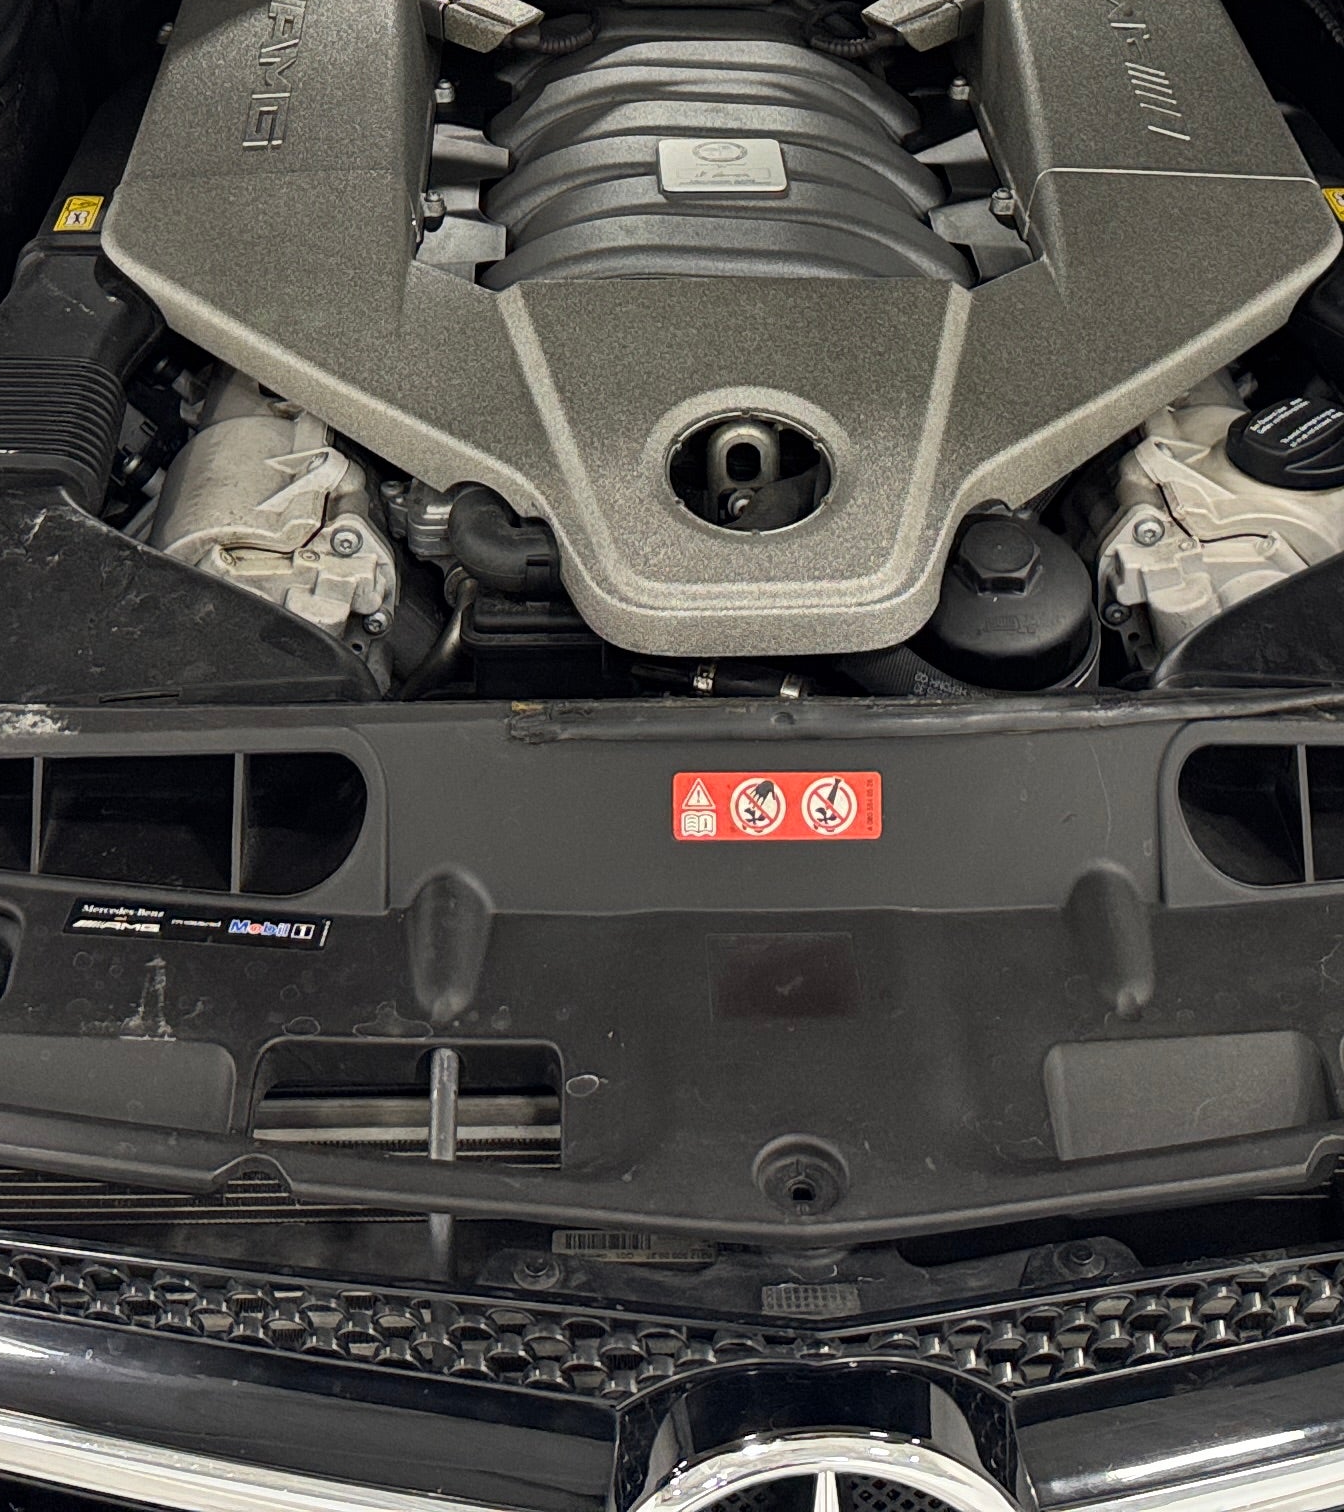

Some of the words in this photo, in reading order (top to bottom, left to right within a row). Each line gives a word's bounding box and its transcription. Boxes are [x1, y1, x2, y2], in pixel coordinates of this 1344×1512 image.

[82, 904, 165, 918] Mercedes-Benz
[100, 920, 160, 933] AMG
[228, 919, 291, 938] Mobil
